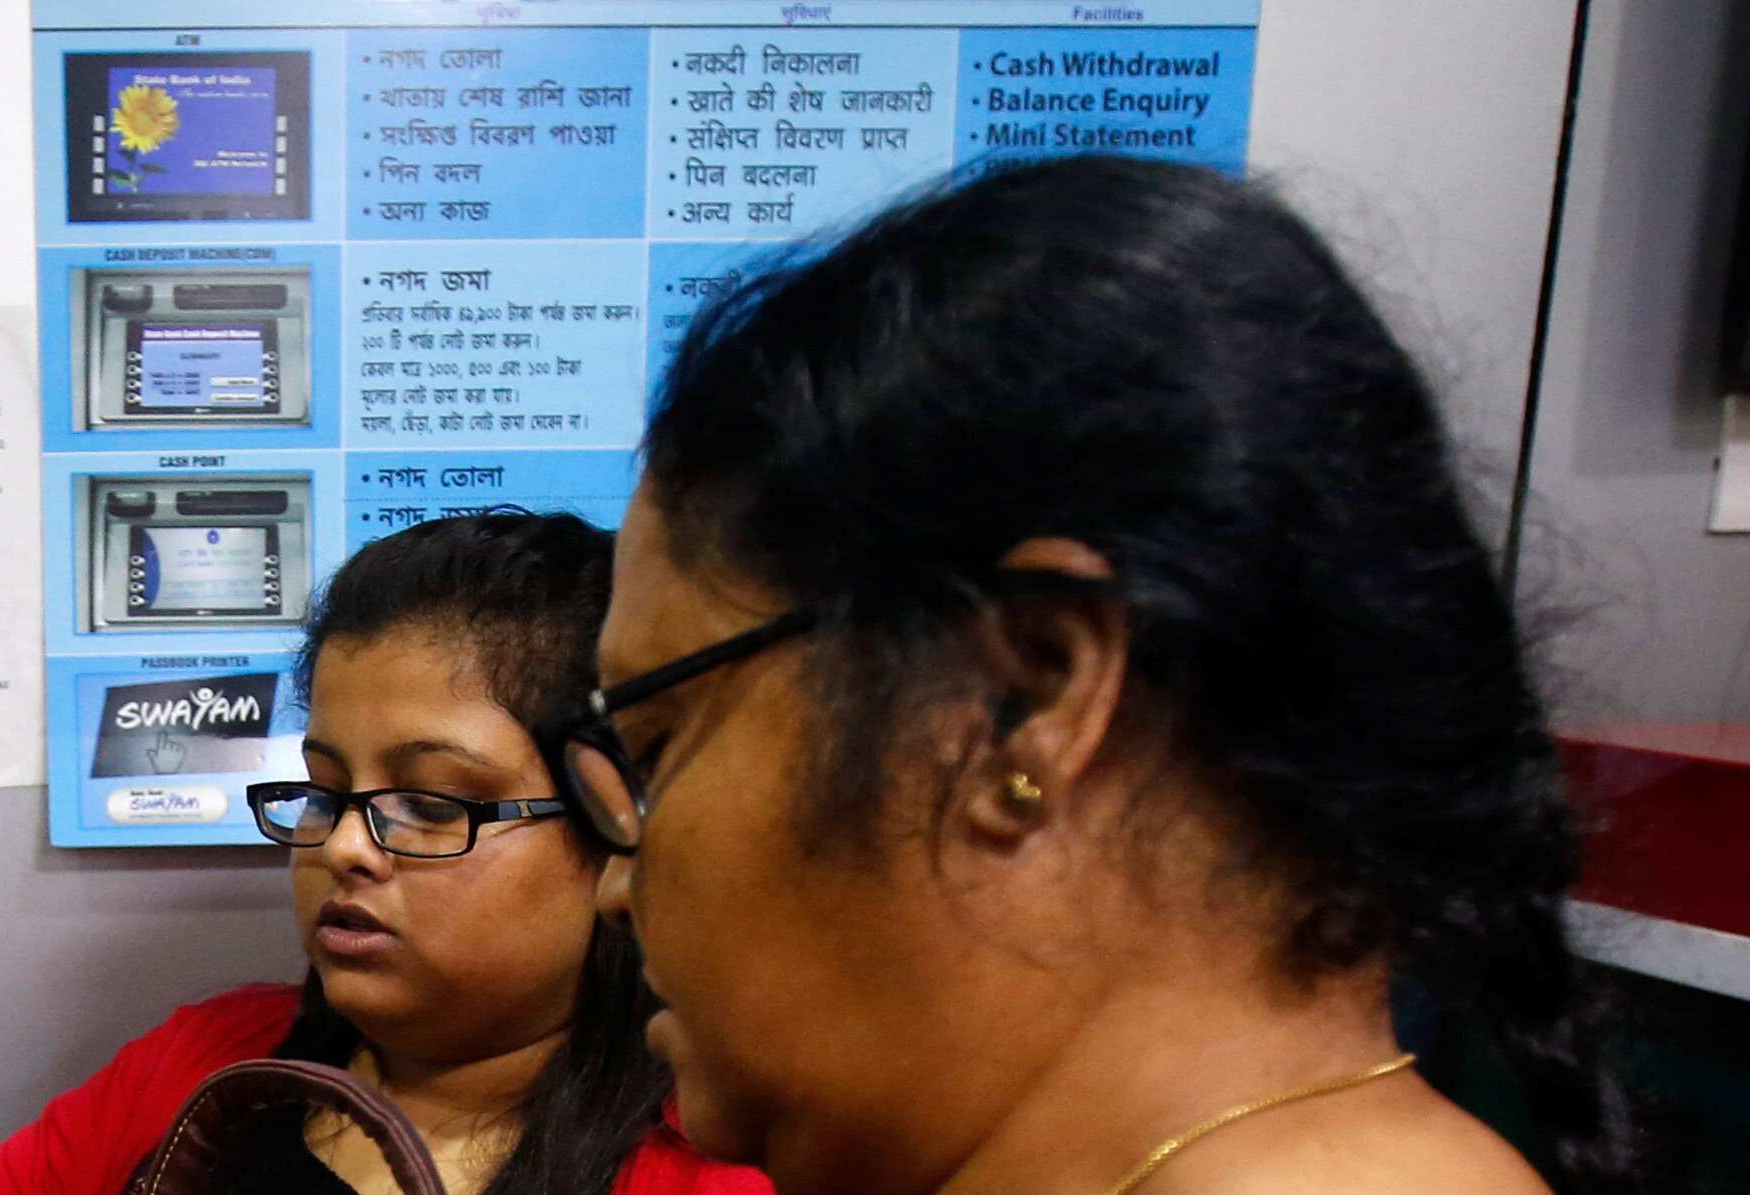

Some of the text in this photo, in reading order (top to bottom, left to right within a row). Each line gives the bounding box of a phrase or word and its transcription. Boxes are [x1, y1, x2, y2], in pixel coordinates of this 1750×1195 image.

[1072, 6, 1145, 21] Facilities
[175, 35, 200, 46] ATM
[379, 48, 504, 70] নগদ তোলা
[685, 44, 862, 75] नकदी निकालना
[990, 51, 1220, 77] Cash Withdrawal
[169, 74, 200, 86] Bank
[380, 79, 632, 109] খাতায় শেষ রাশি জানা
[687, 82, 934, 113] खाते की शेष जानकारी
[988, 87, 1210, 119] Balance Enquiry
[470, 117, 536, 146] বিবরণ
[549, 124, 617, 146] পাওয়া
[686, 119, 910, 150] संक्षिप्त विवरण प्राप्त
[985, 123, 1197, 147] Mini Statement
[379, 156, 483, 184] পিন বদল
[685, 157, 818, 187] पिन बदलना
[379, 200, 491, 221] অন্য কাজ
[682, 192, 796, 224] अन्य कार्य
[105, 249, 136, 261] CASH
[138, 248, 186, 260] DEPOSIT
[379, 269, 491, 292] নগদ জমা
[158, 455, 227, 468] CASH POINT
[378, 465, 506, 488] নগদ তোলা
[141, 655, 250, 668] PASSBOOK PRINTER
[115, 687, 261, 731] SWAYAM
